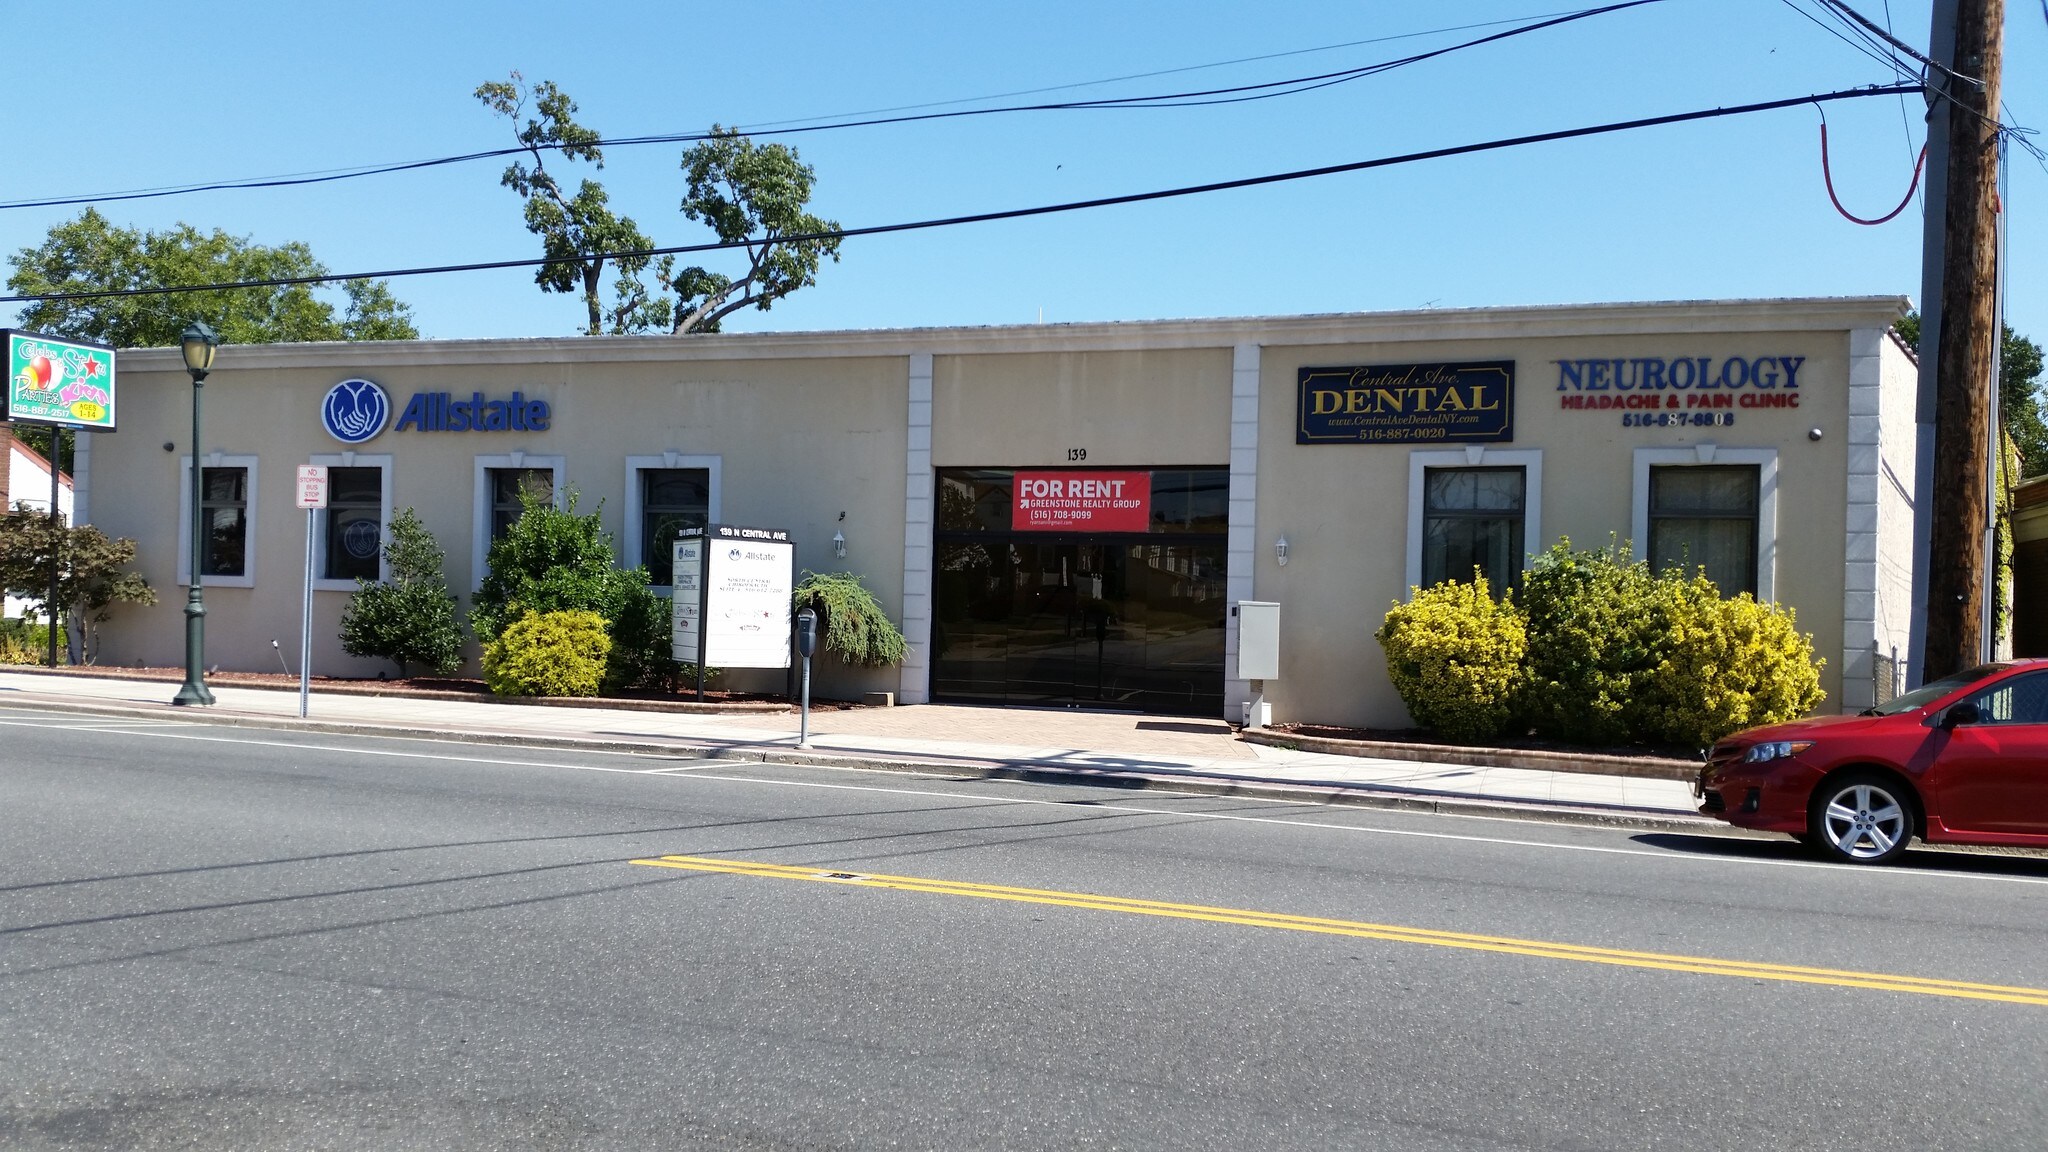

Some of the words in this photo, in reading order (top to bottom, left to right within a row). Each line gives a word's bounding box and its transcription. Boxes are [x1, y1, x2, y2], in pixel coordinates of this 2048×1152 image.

[1350, 364, 1416, 388] Central
[1415, 365, 1460, 385] Ave.
[1556, 356, 1805, 391] NEUROLOGY
[14, 374, 60, 405] PARTIES
[78, 403, 97, 411] AGES
[1312, 386, 1499, 415] DENTAL
[1561, 395, 1660, 410] HEADACHE
[1666, 394, 1680, 409] &
[1687, 394, 1733, 409] PAIN
[1739, 393, 1799, 408] CLINIC
[13, 404, 70, 417] 516-887-2517
[394, 391, 551, 432] Allstate
[1328, 414, 1480, 427] www.CentralAveDentalNY.com
[1359, 428, 1446, 440] 516-887-0020
[1067, 448, 1087, 461] 139
[1020, 480, 1063, 498] FOR
[1068, 480, 1126, 498] RENT
[1030, 499, 1081, 508] GREENSTONE
[1083, 499, 1111, 508] REALTY
[1113, 500, 1141, 508] GROUP
[1030, 510, 1051, 521] (516)
[1053, 510, 1092, 519] 708-9099
[719, 528, 733, 536] 139
[734, 529, 741, 537] N
[741, 530, 772, 539] CENTRAL
[772, 532, 787, 540] AVE
[744, 551, 776, 561] Allstate
